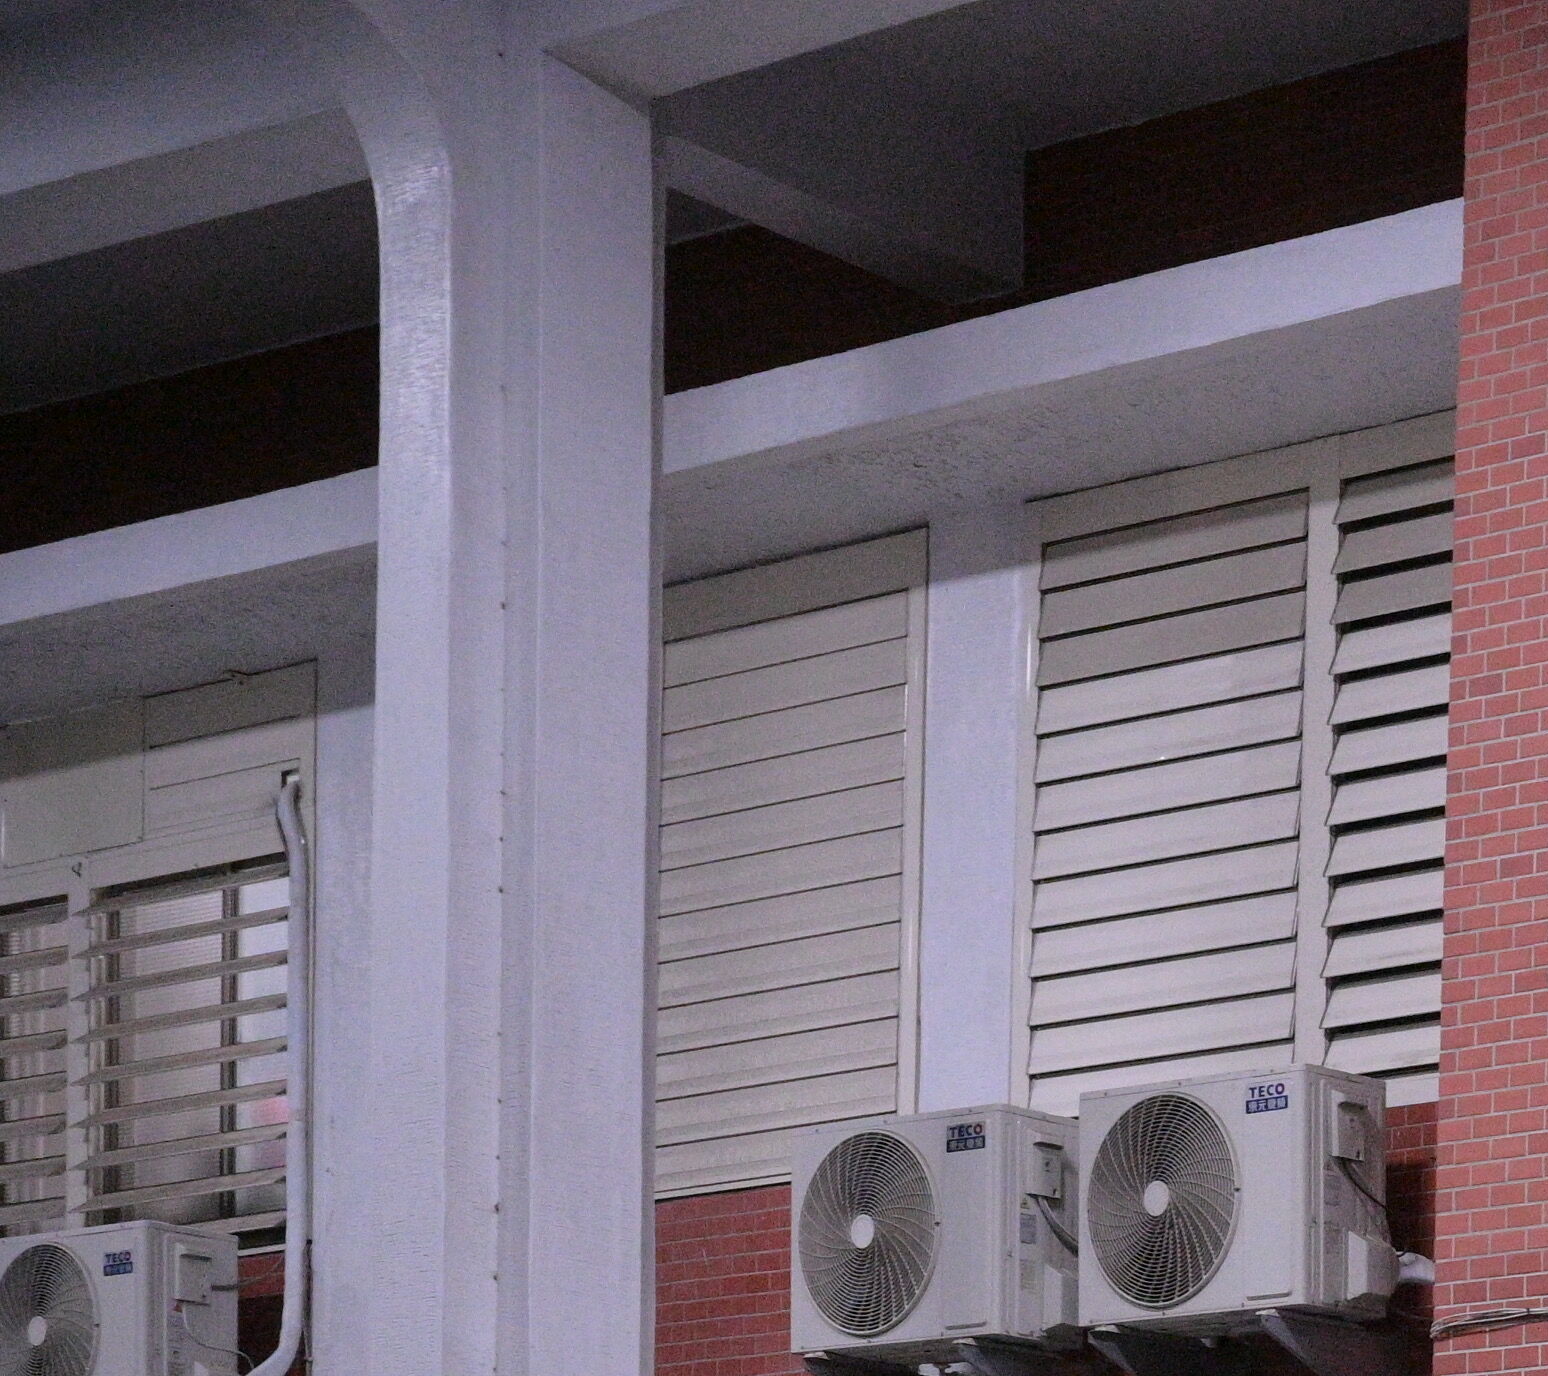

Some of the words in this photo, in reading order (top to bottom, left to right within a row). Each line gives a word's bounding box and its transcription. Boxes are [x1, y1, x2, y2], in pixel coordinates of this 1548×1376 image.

[1248, 1082, 1285, 1099] TECO
[949, 1123, 983, 1139] TECO
[104, 1251, 132, 1264] TECO
